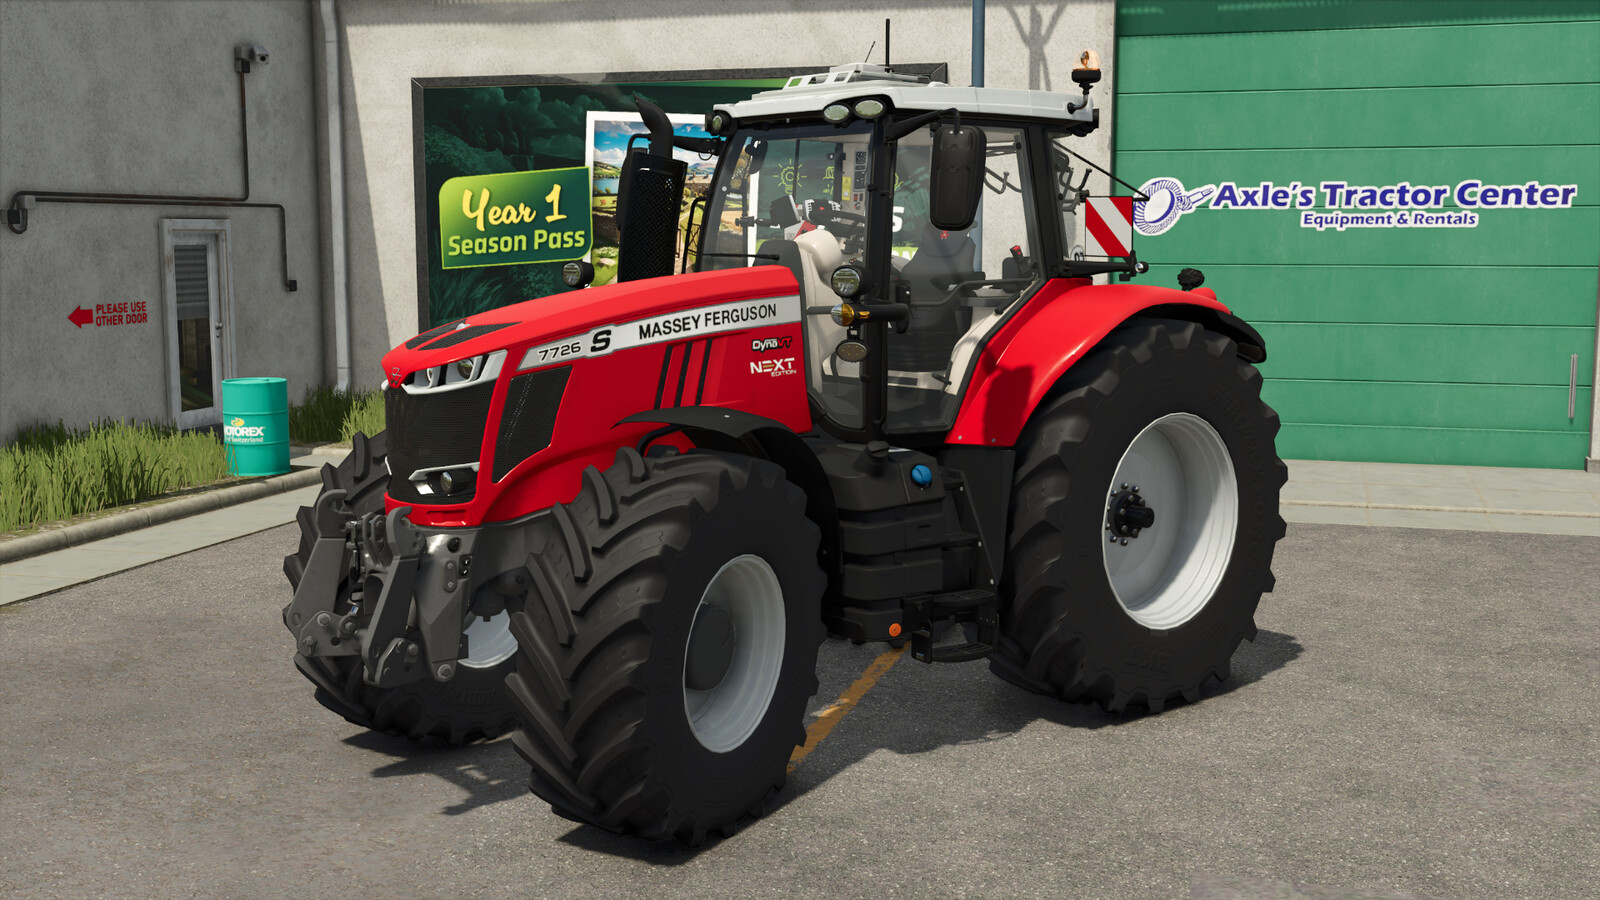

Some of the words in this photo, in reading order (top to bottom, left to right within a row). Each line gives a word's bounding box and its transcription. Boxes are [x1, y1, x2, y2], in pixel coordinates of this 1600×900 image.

[1212, 184, 1314, 207] Axle's
[1323, 183, 1448, 207] Tractor
[1456, 182, 1576, 206] Center
[462, 187, 537, 232] Year
[545, 183, 568, 223] 1
[1303, 213, 1393, 228] Equipment
[1396, 213, 1409, 225] &
[1413, 213, 1476, 225] Rentals
[448, 234, 527, 256] Season
[534, 229, 586, 250] Pass
[96, 302, 129, 315] PLEASE
[130, 301, 147, 313] USE
[95, 314, 124, 327] OTHER
[125, 312, 148, 325] DOOR
[638, 314, 701, 340] MASSEY
[704, 303, 777, 328] FERGUSON
[538, 341, 582, 362] 7726
[589, 328, 612, 353] S
[750, 357, 795, 375] NEXT
[770, 369, 797, 378] EDITION
